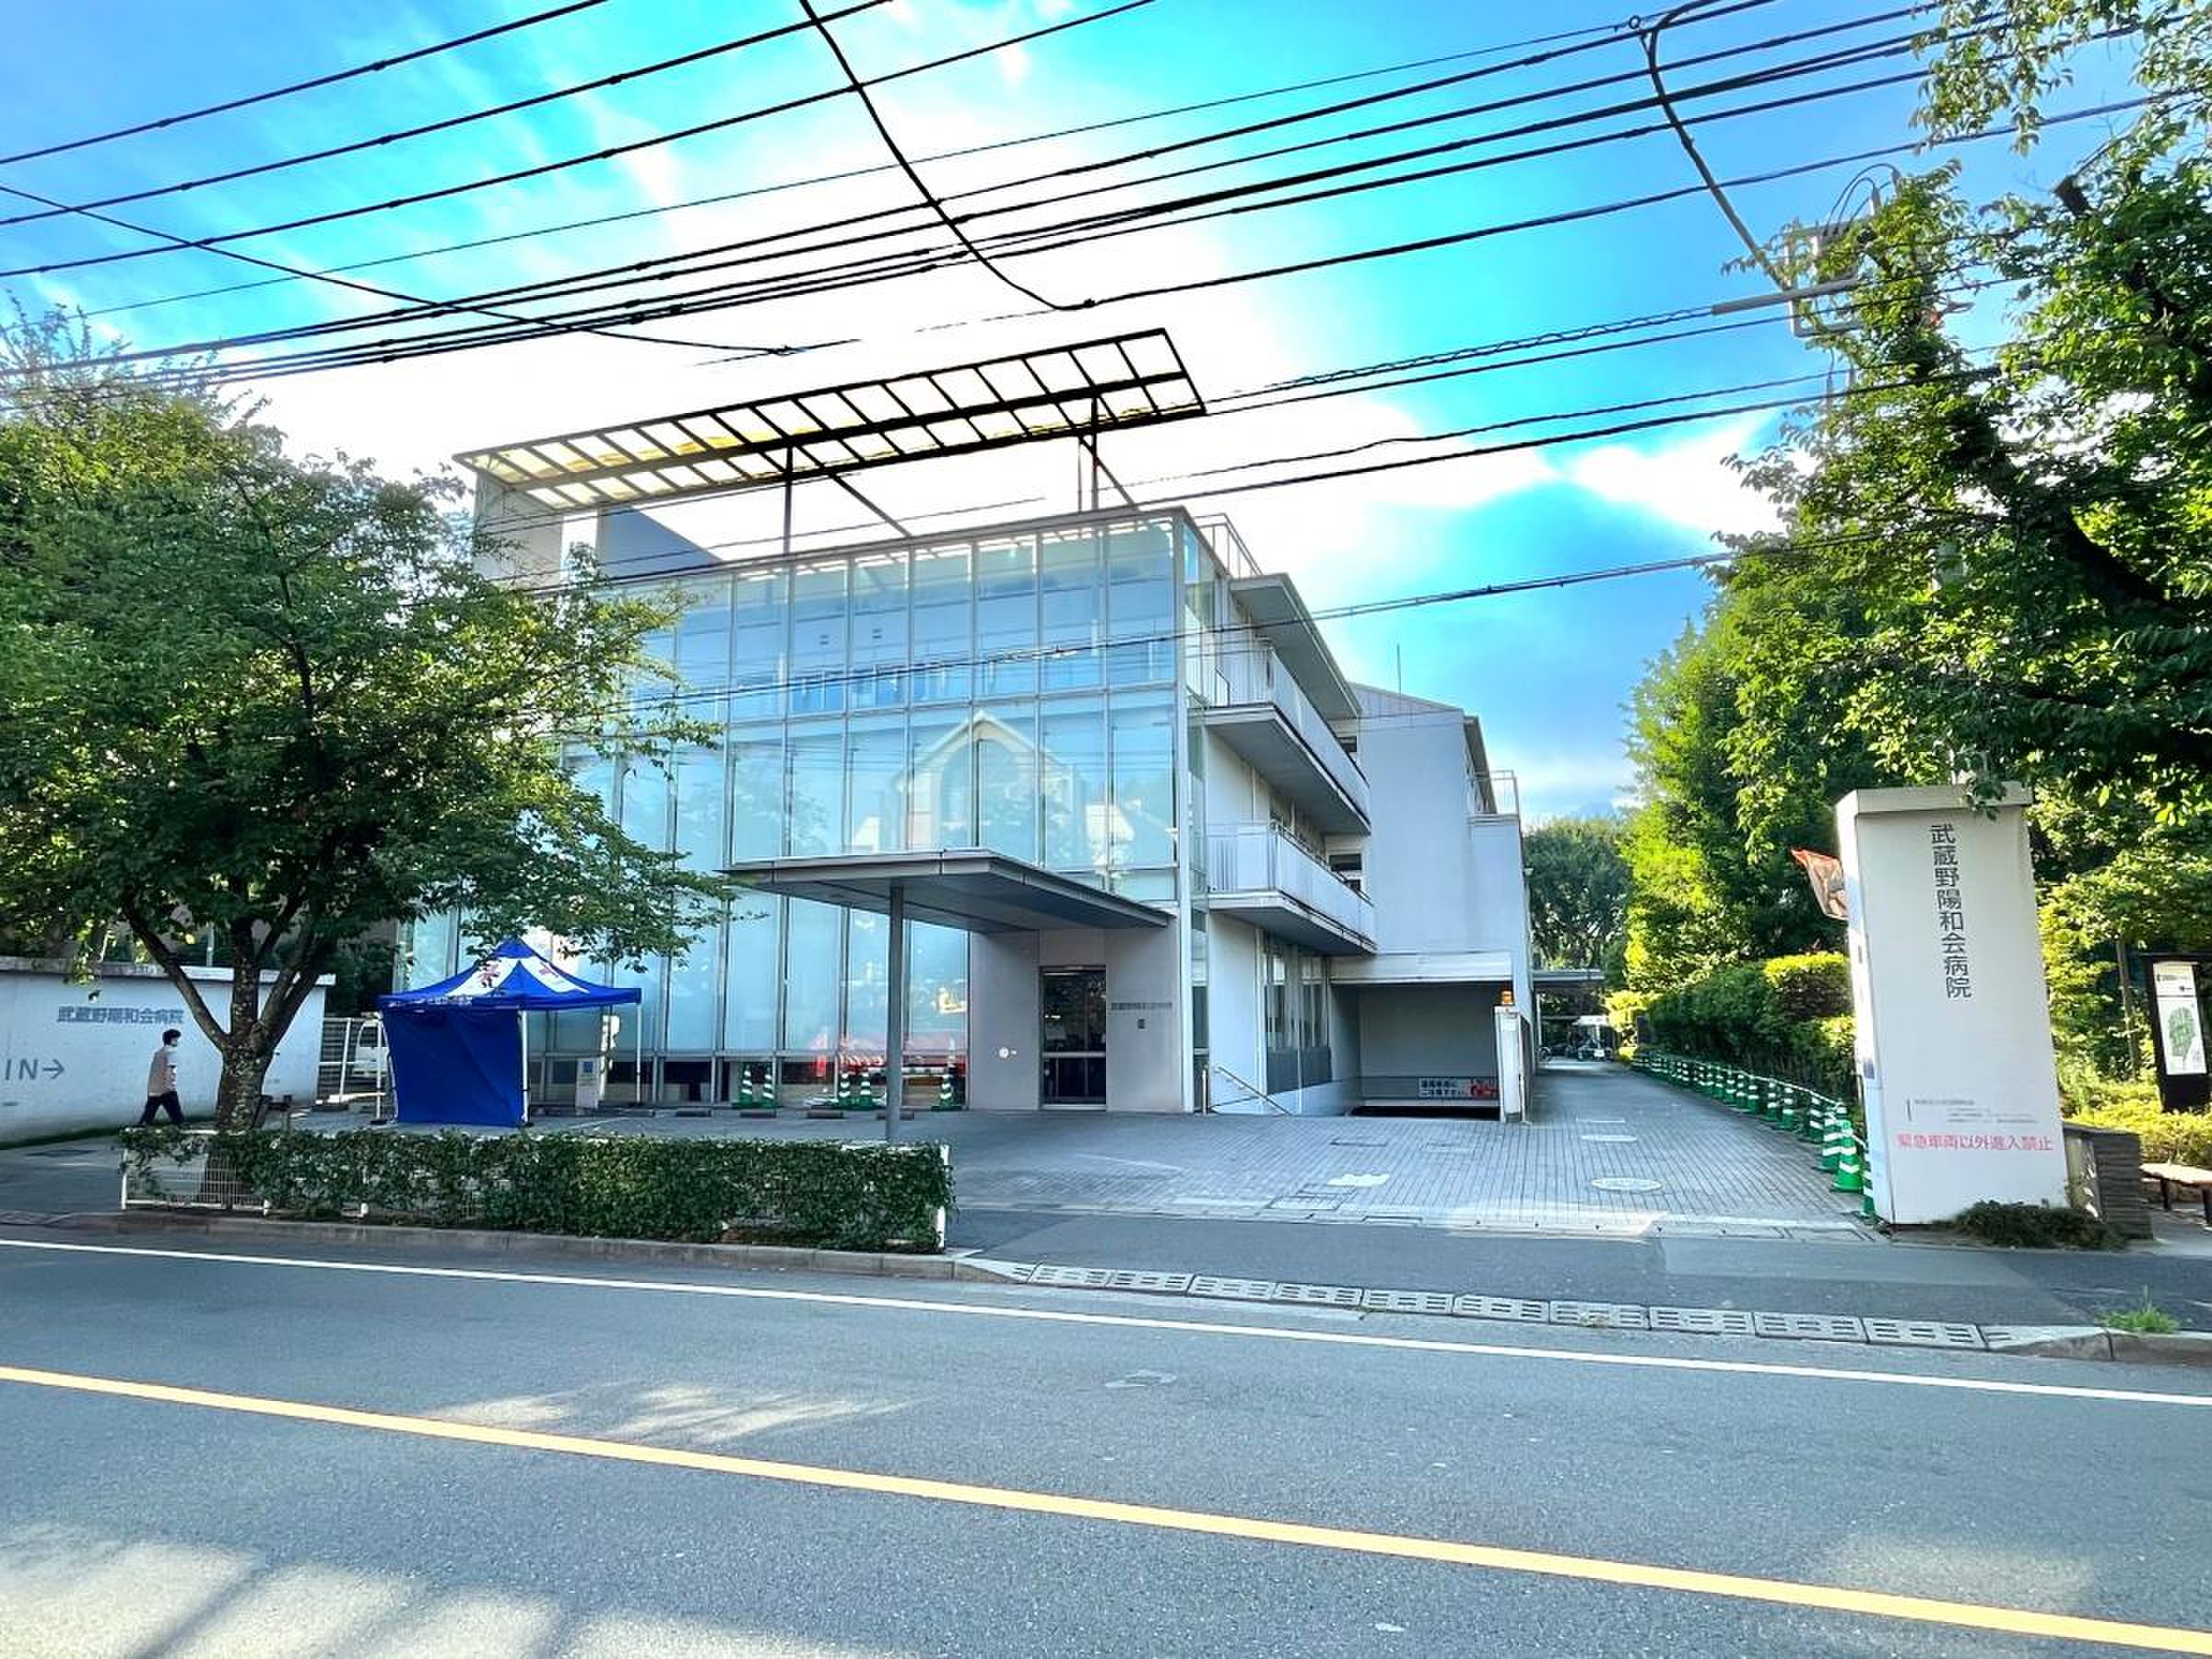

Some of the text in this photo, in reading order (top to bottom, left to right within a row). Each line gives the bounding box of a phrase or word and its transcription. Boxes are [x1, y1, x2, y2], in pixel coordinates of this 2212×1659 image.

[1931, 823, 1971, 999] 武蔵野陽和会病院
[6, 1058, 38, 1080] IN
